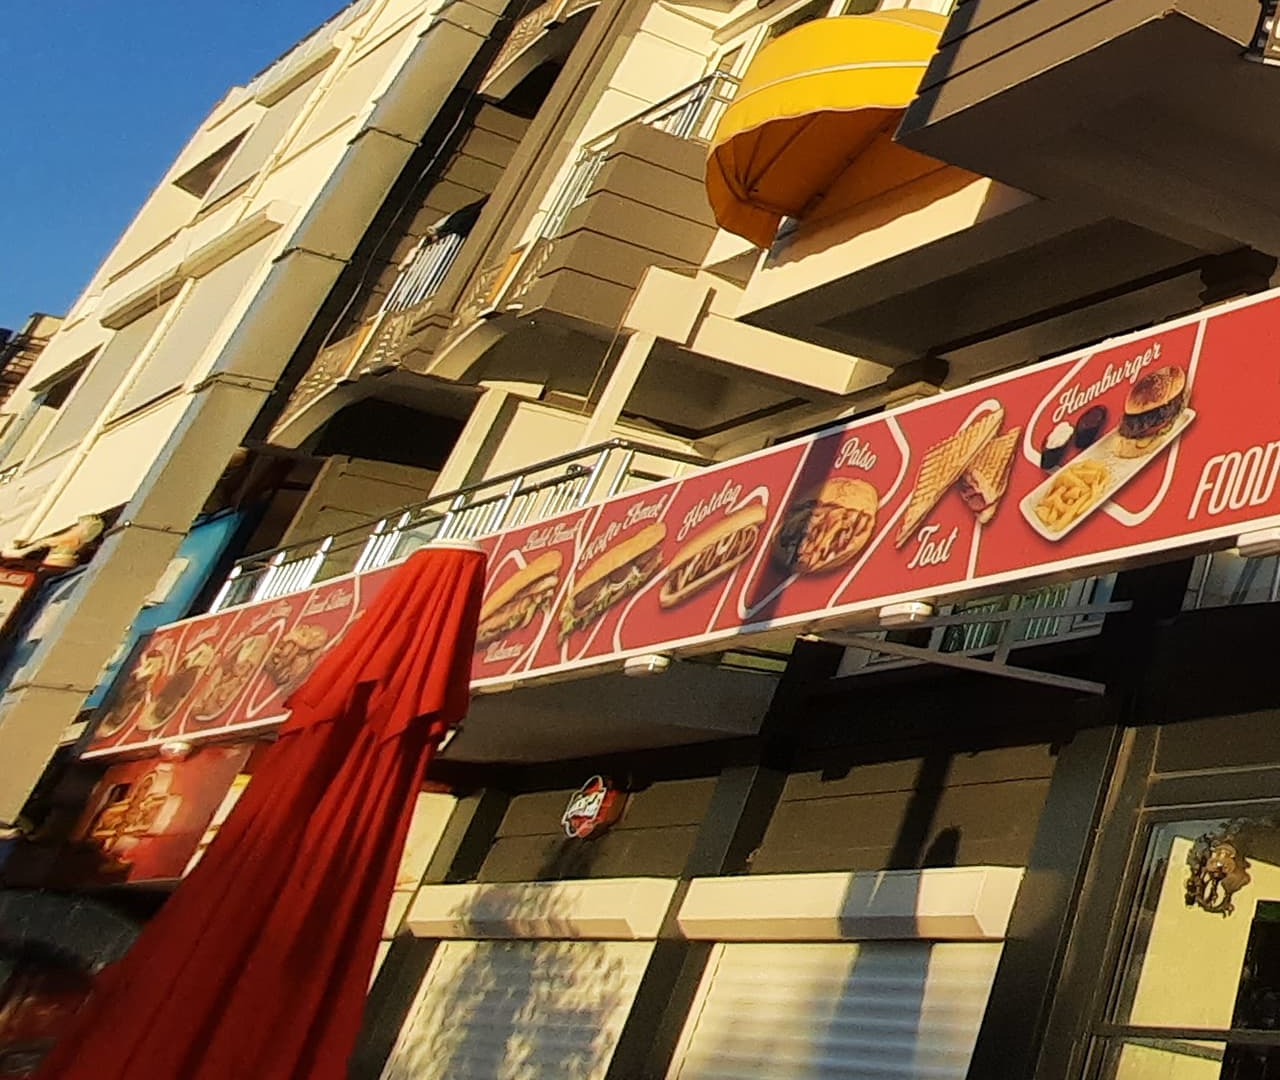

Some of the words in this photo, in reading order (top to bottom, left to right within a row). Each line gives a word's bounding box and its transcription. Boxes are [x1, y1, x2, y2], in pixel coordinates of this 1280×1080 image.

[1052, 342, 1162, 423] Hamburger
[834, 437, 877, 470] Patso
[676, 478, 743, 541] Hotdog
[906, 523, 959, 569] Tost
